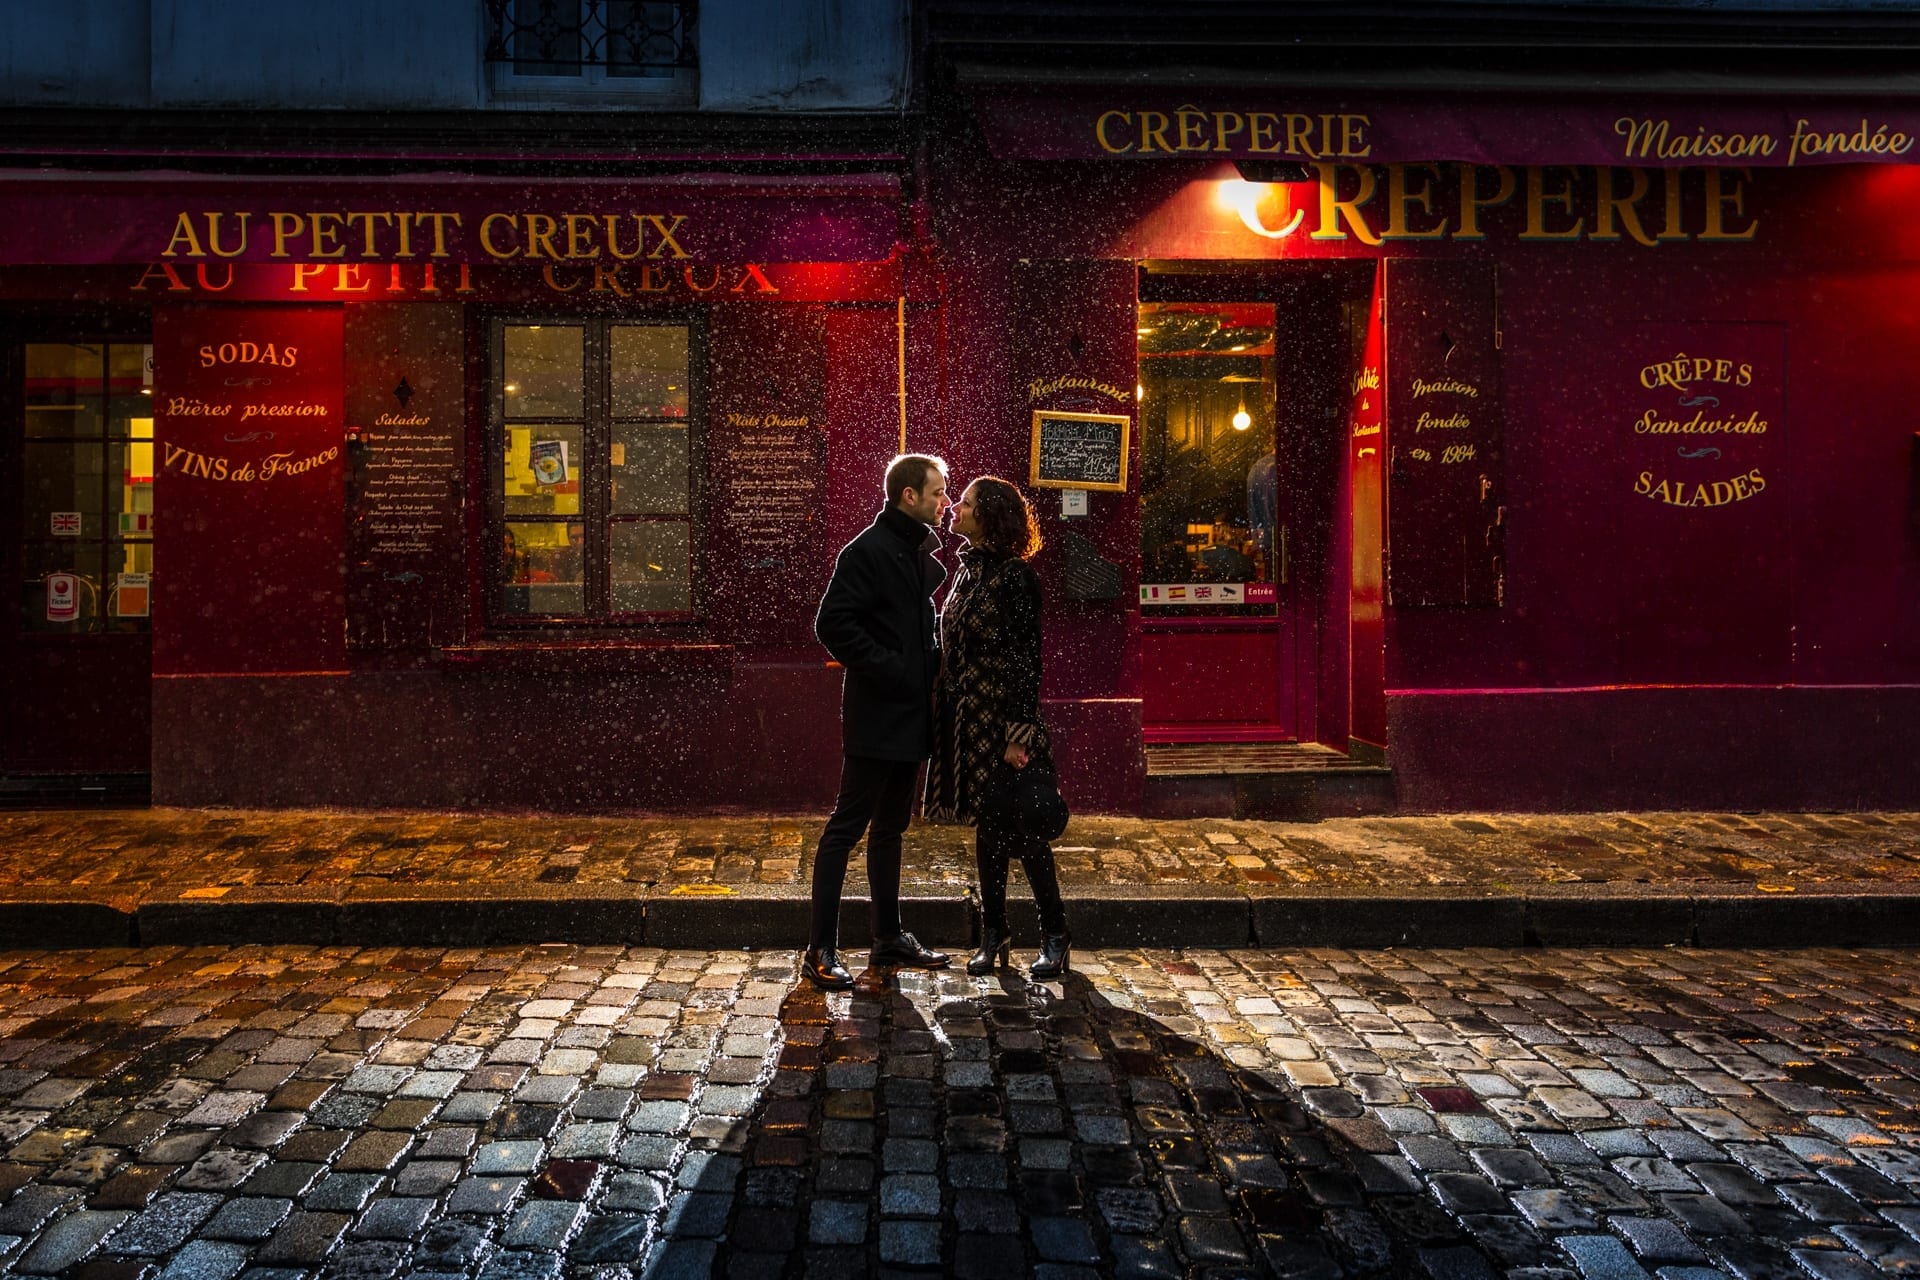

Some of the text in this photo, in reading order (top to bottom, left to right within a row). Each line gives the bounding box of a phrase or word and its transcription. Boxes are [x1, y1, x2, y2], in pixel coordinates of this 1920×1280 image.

[1095, 104, 1372, 158] CRÊPERIE
[1614, 117, 1915, 167] Maison fondée
[161, 211, 693, 261] AU PETIT CREUX
[199, 342, 298, 368] SODAS
[1640, 352, 1753, 392] CRÊPES
[1028, 375, 1131, 403] Restaurant
[166, 396, 328, 422] Bières pression
[375, 412, 430, 426] Salades
[1416, 411, 1471, 433] fondée
[1634, 409, 1768, 434] Sandwichs
[164, 441, 339, 482] VINS de France
[1409, 443, 1477, 464] en 1984
[1634, 468, 1767, 507] SALADES
[1247, 587, 1274, 597] Entrée
